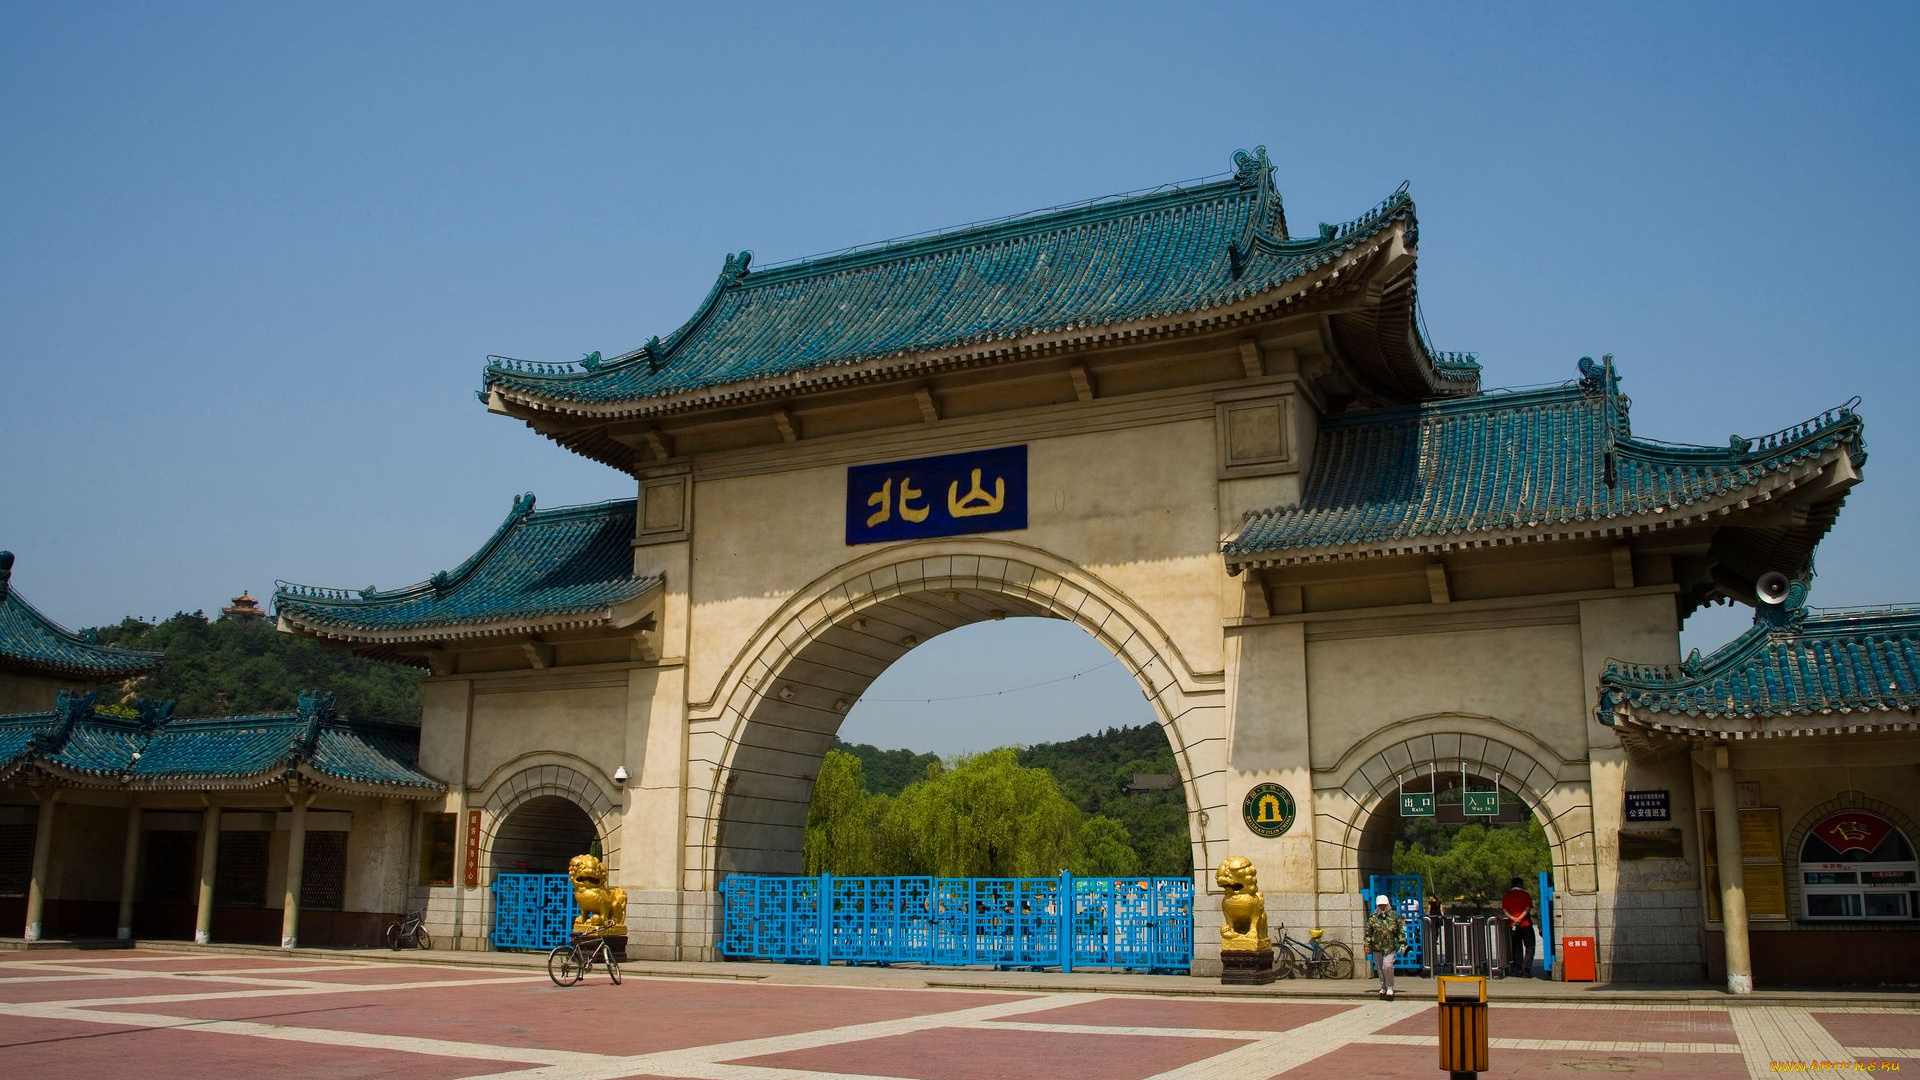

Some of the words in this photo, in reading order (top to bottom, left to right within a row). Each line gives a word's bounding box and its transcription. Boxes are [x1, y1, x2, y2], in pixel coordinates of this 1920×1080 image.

[866, 468, 1005, 528] 北山
[1404, 797, 1431, 808] 出口
[1469, 796, 1495, 806] 入口
[1629, 808, 1667, 817] 公安值班室
